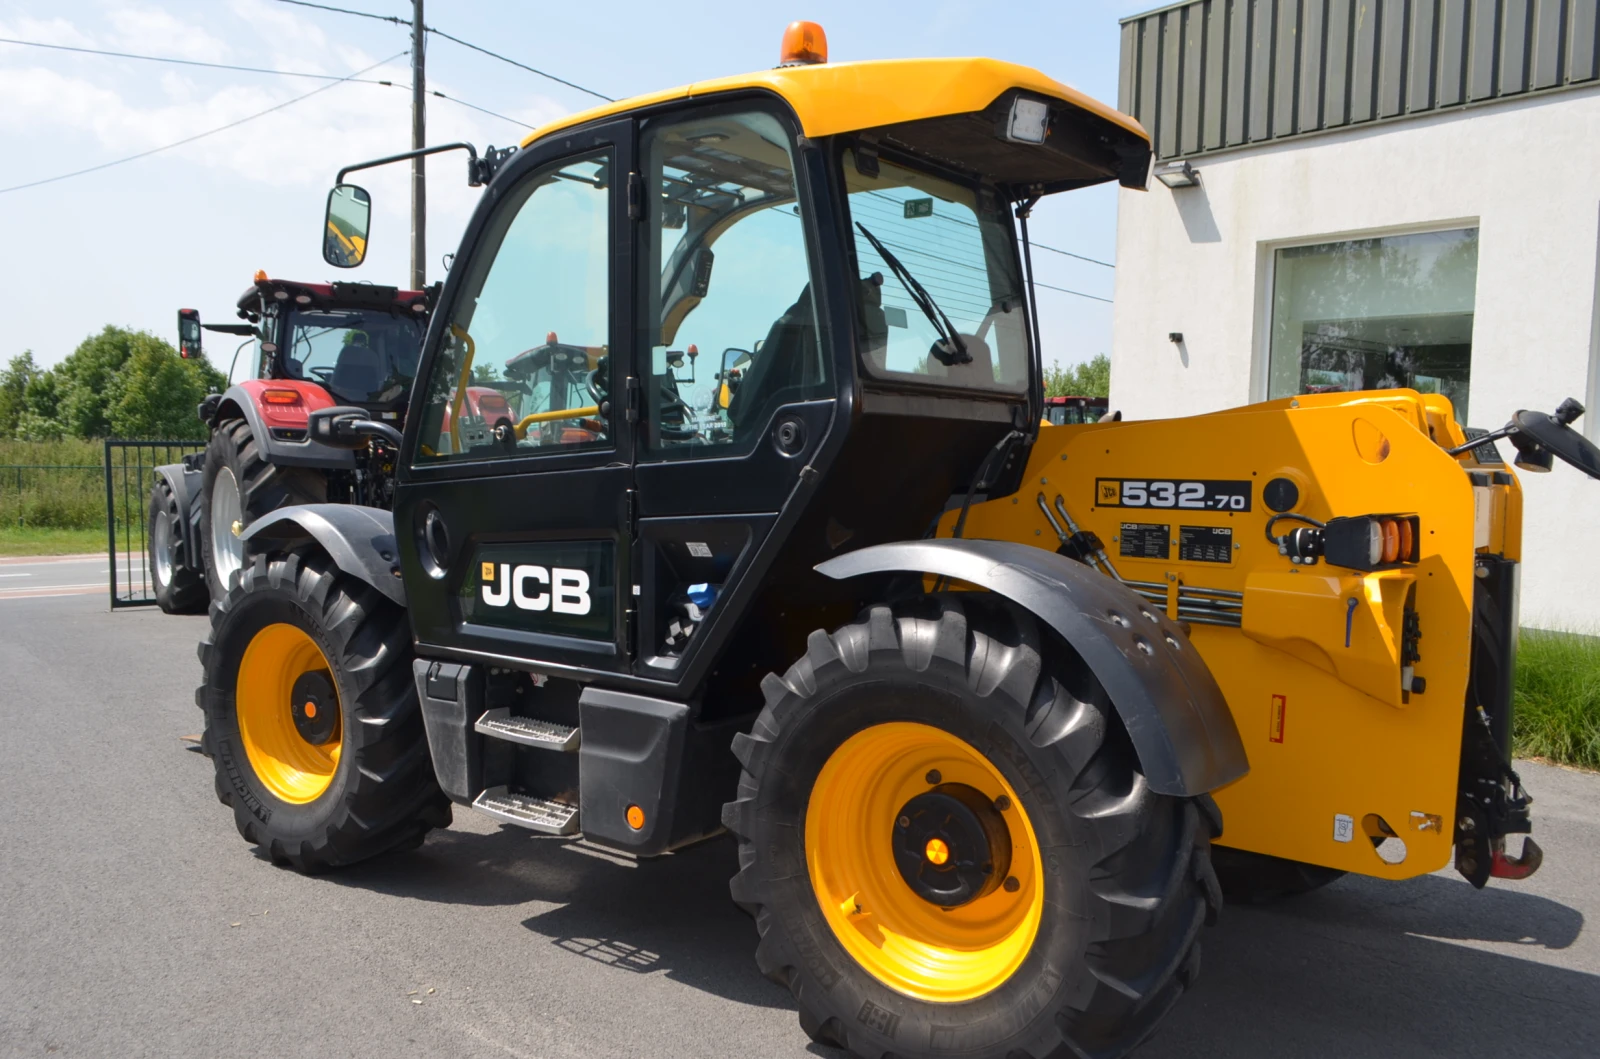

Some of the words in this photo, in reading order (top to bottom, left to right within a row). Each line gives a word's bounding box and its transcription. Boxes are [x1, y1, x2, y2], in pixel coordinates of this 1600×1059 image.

[1122, 481, 1246, 510] 532-70
[481, 563, 591, 615] JCB
[219, 742, 261, 813] MICHELIN
